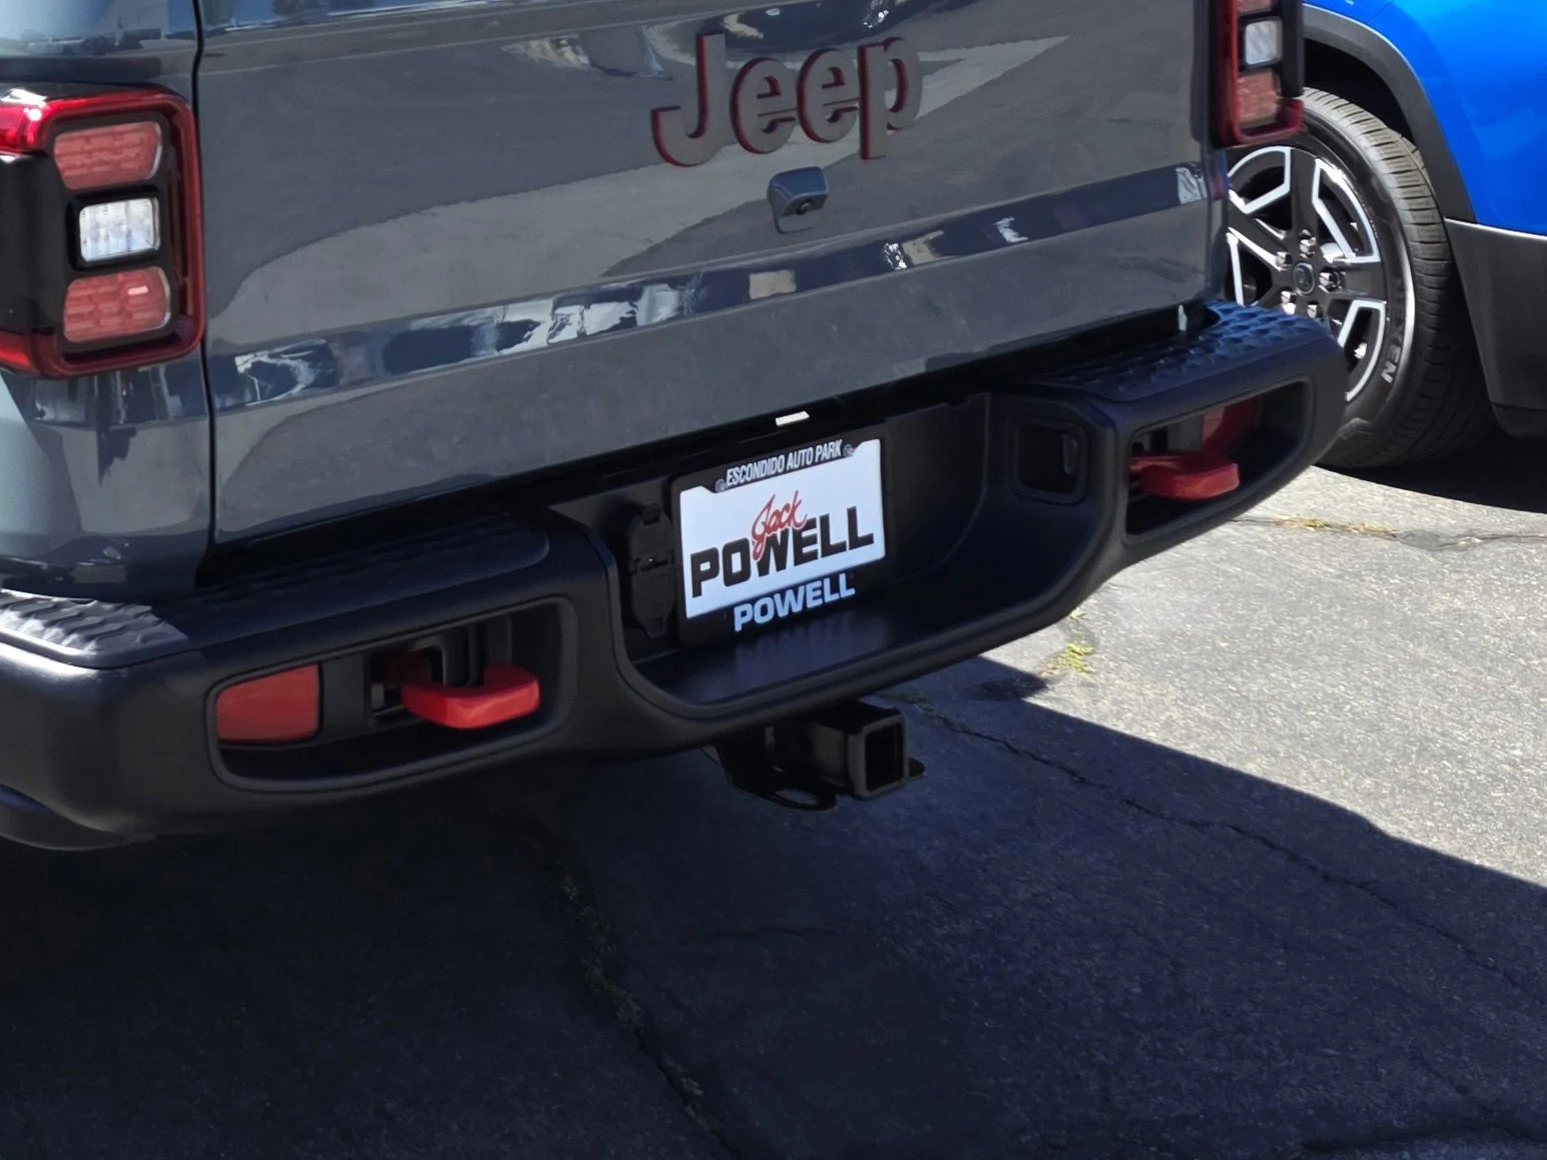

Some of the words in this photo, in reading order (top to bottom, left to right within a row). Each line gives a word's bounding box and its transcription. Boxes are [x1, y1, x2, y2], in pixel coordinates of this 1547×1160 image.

[651, 30, 922, 167] Jeep
[725, 456, 786, 487] ESCONDIDO
[786, 447, 814, 471] AUTO
[814, 439, 844, 463] PARK
[690, 505, 874, 598] POWELL
[751, 490, 808, 561] Jack
[734, 572, 856, 632] POWELL
